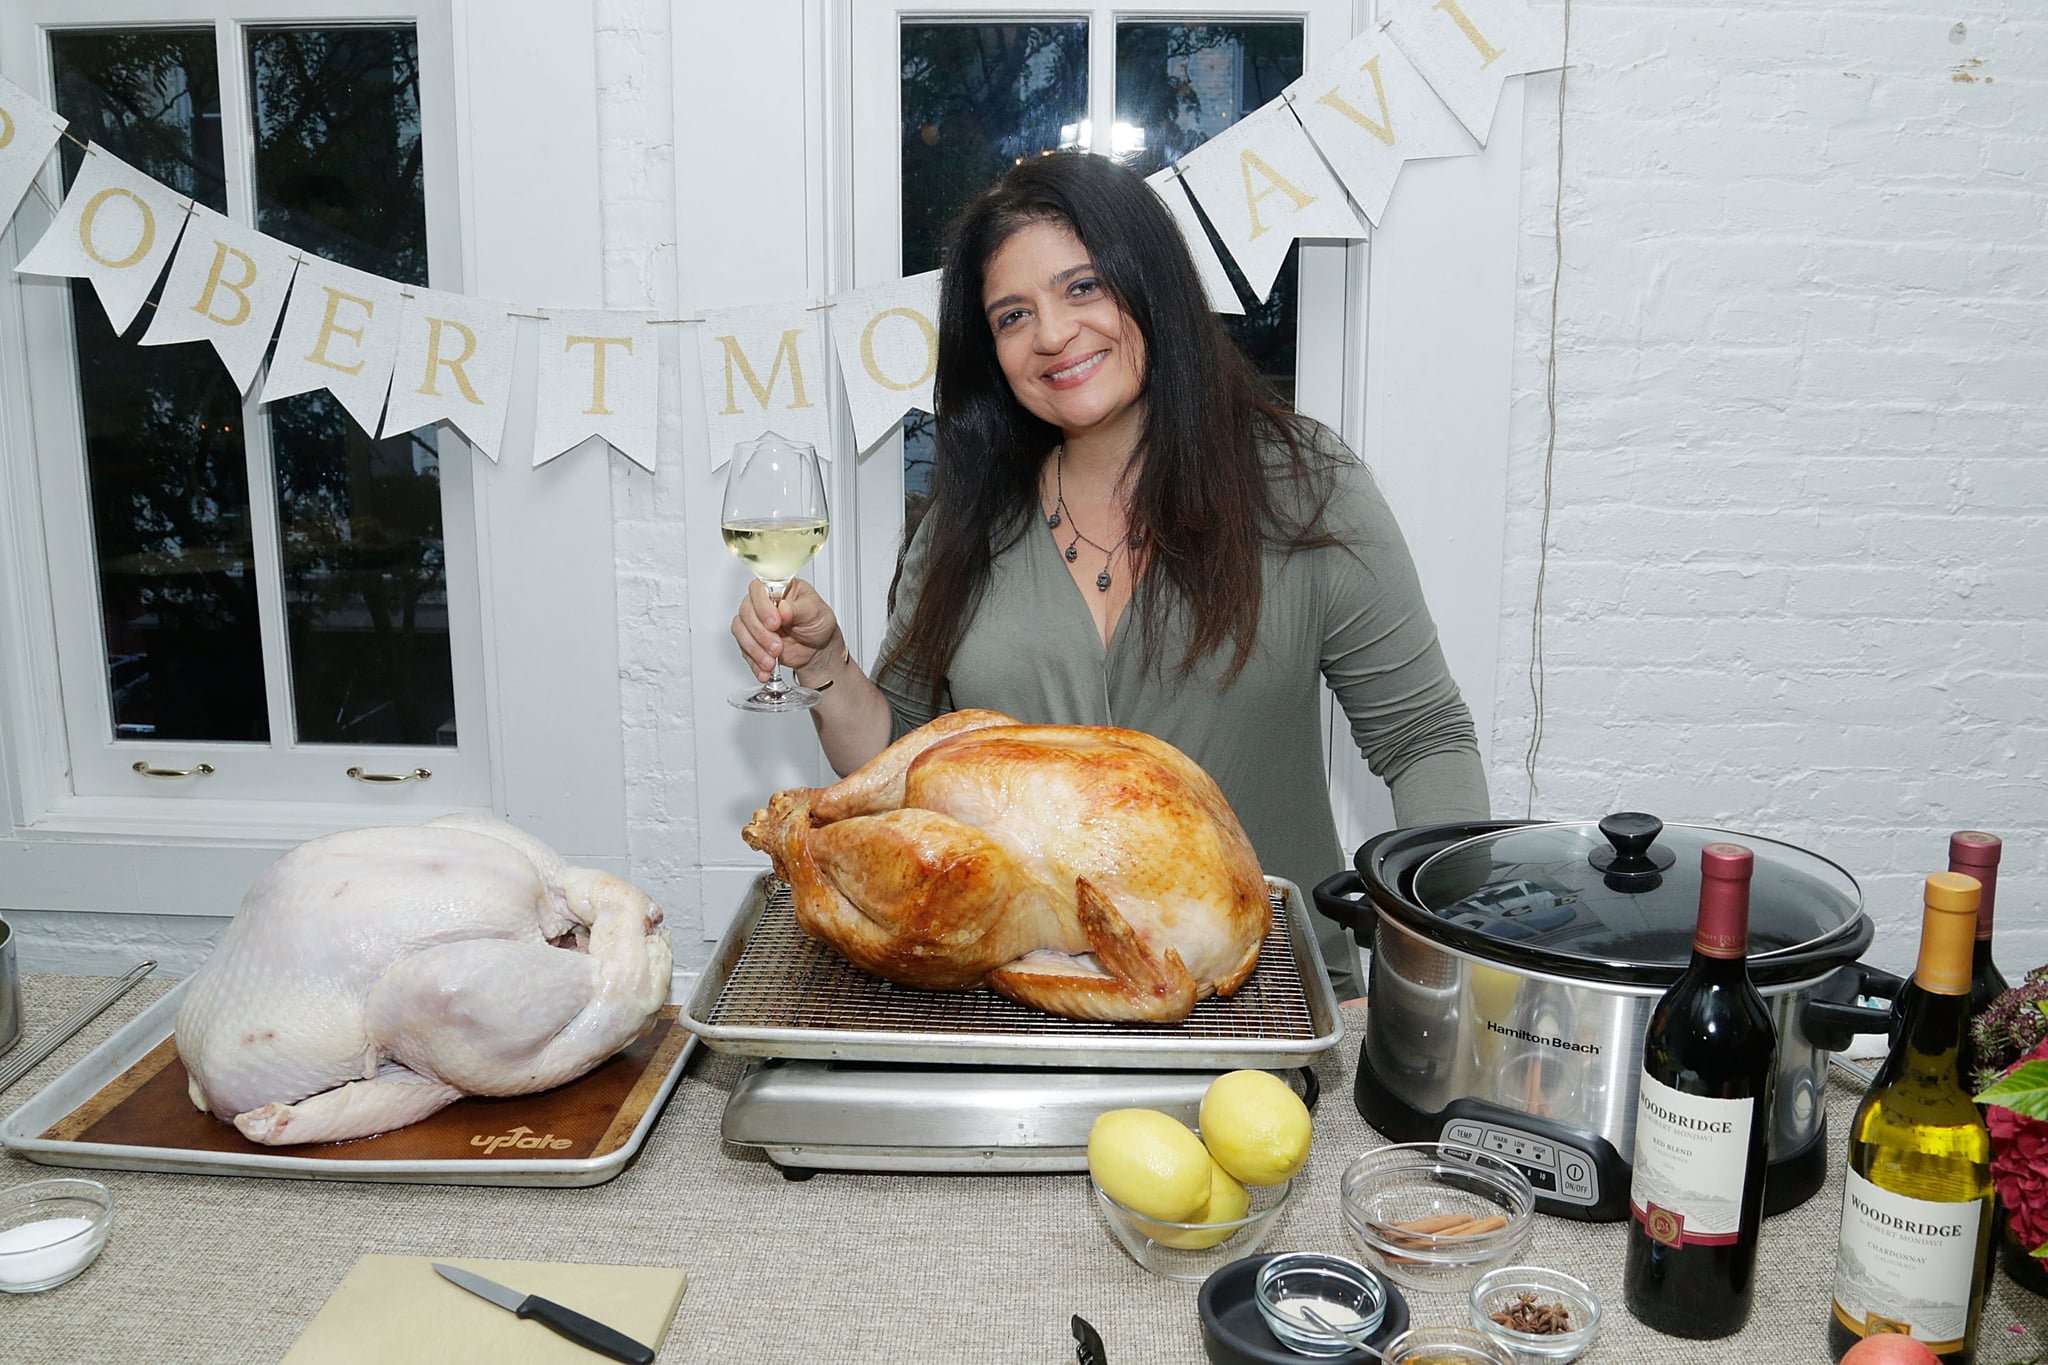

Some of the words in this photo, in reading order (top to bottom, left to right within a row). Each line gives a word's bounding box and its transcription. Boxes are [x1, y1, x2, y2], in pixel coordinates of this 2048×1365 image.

[1487, 1020, 1550, 1046] Hamilton
[1552, 1037, 1600, 1055] Beach
[1457, 1129, 1473, 1141] TEMP
[1493, 1135, 1508, 1144] WARM
[1513, 1139, 1525, 1149] LOW
[1532, 1145, 1546, 1154] HIGH
[1652, 1136, 1666, 1148] RED
[1666, 1142, 1693, 1157] BLEND
[1564, 1181, 1589, 1195] ON/OFF
[1851, 1193, 1962, 1238] WOODBRIDGE
[1866, 1221, 1897, 1239] ROBERT
[1900, 1234, 1943, 1247] MONDAVI
[1867, 1240, 1927, 1264] CHARDONNAY
